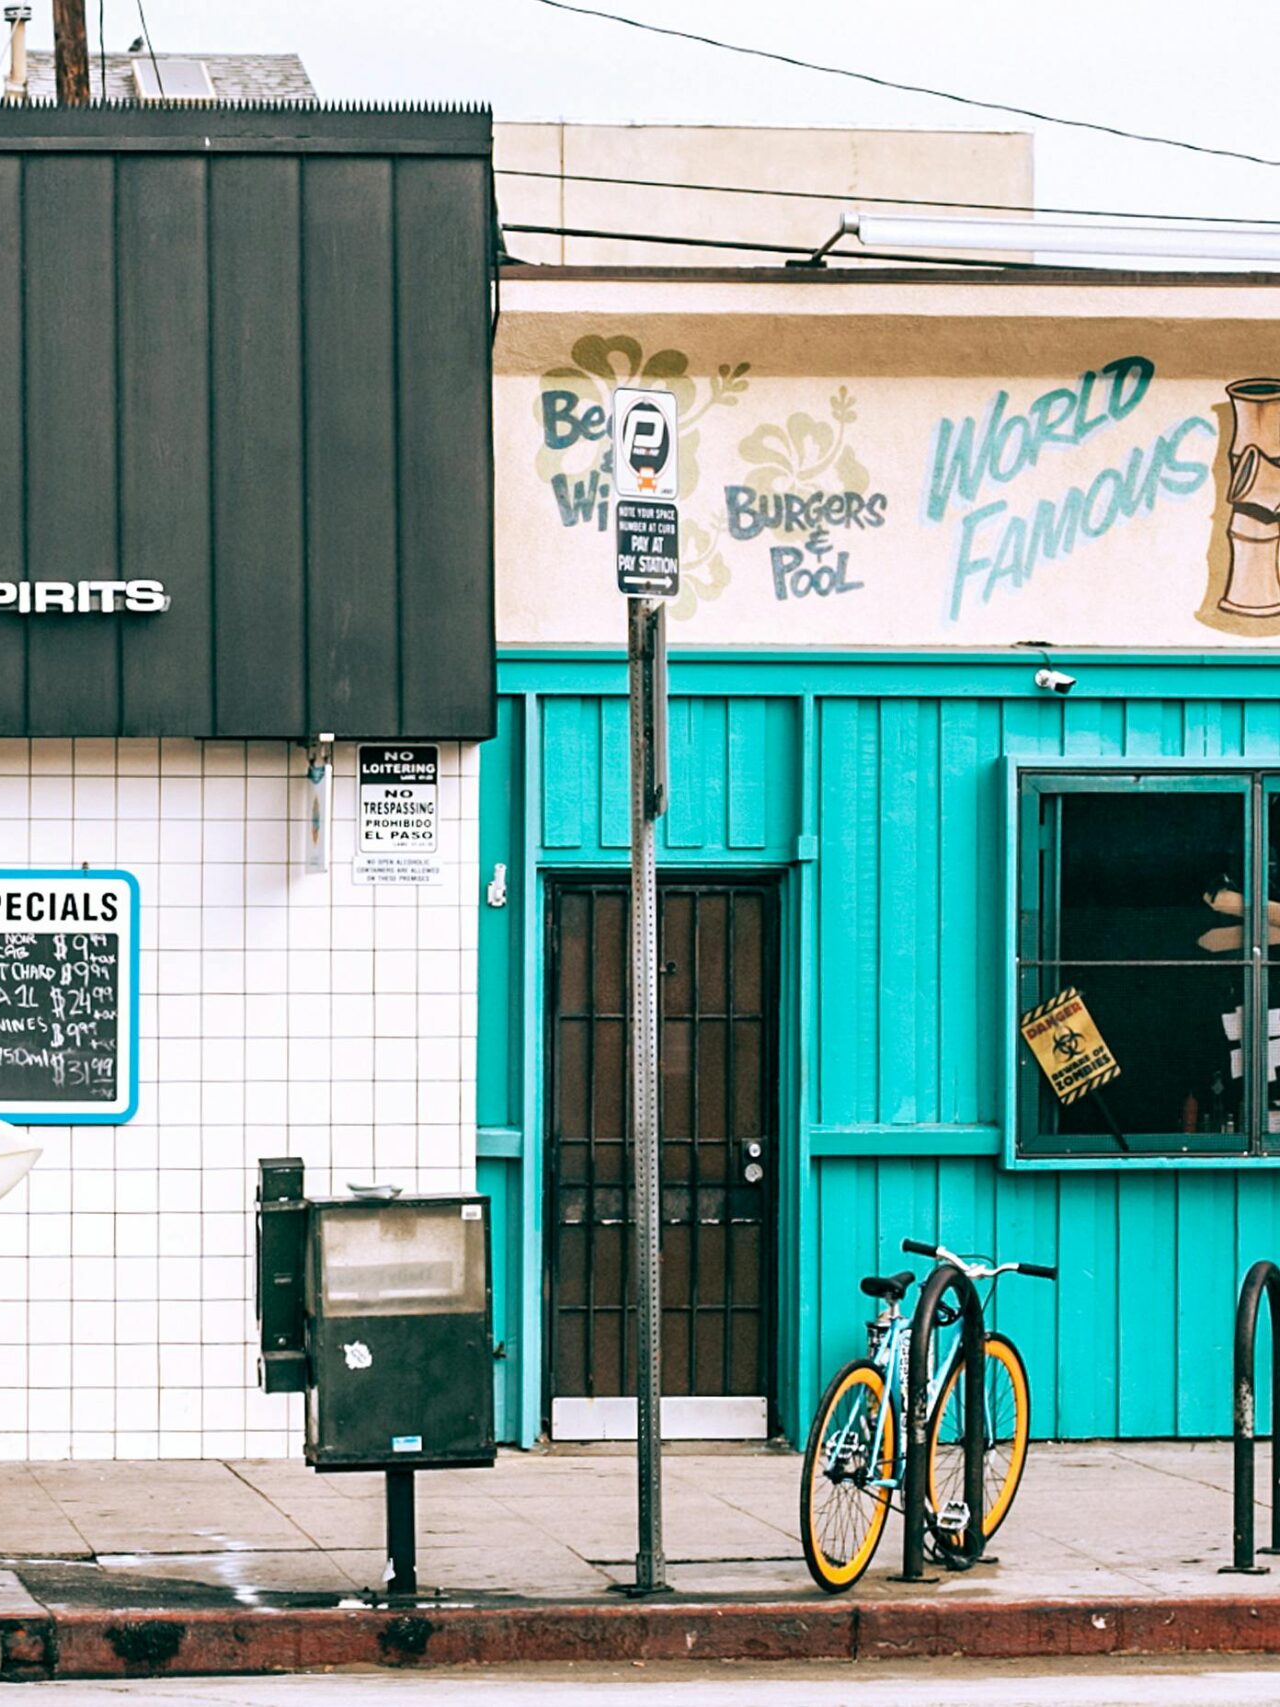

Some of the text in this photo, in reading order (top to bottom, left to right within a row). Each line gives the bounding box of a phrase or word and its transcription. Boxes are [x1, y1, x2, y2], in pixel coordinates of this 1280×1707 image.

[541, 389, 613, 450] Be
[924, 355, 1155, 523] WORLD
[551, 470, 610, 532] Wi
[619, 507, 676, 520] NOTE YOUR SPACE
[946, 416, 1217, 623] FAMOUS
[619, 521, 676, 534] NUMBER AT CURB
[631, 535, 664, 553] PAY AT
[618, 554, 678, 574] PAY STATION
[384, 751, 414, 761] NO
[362, 763, 436, 774] LOITERING
[384, 789, 414, 799] NO
[363, 802, 434, 814] TRESPASSING
[366, 819, 432, 828] PROHIBIDO
[365, 831, 433, 840] EL PASO
[5, 933, 37, 945] NOIR
[11, 962, 56, 982] CHARD
[15, 984, 39, 1008] 1L
[1025, 1002, 1083, 1040] DANGER
[1051, 1045, 1105, 1081] BEWARE OF
[1055, 1054, 1111, 1091] ZOMBIES
